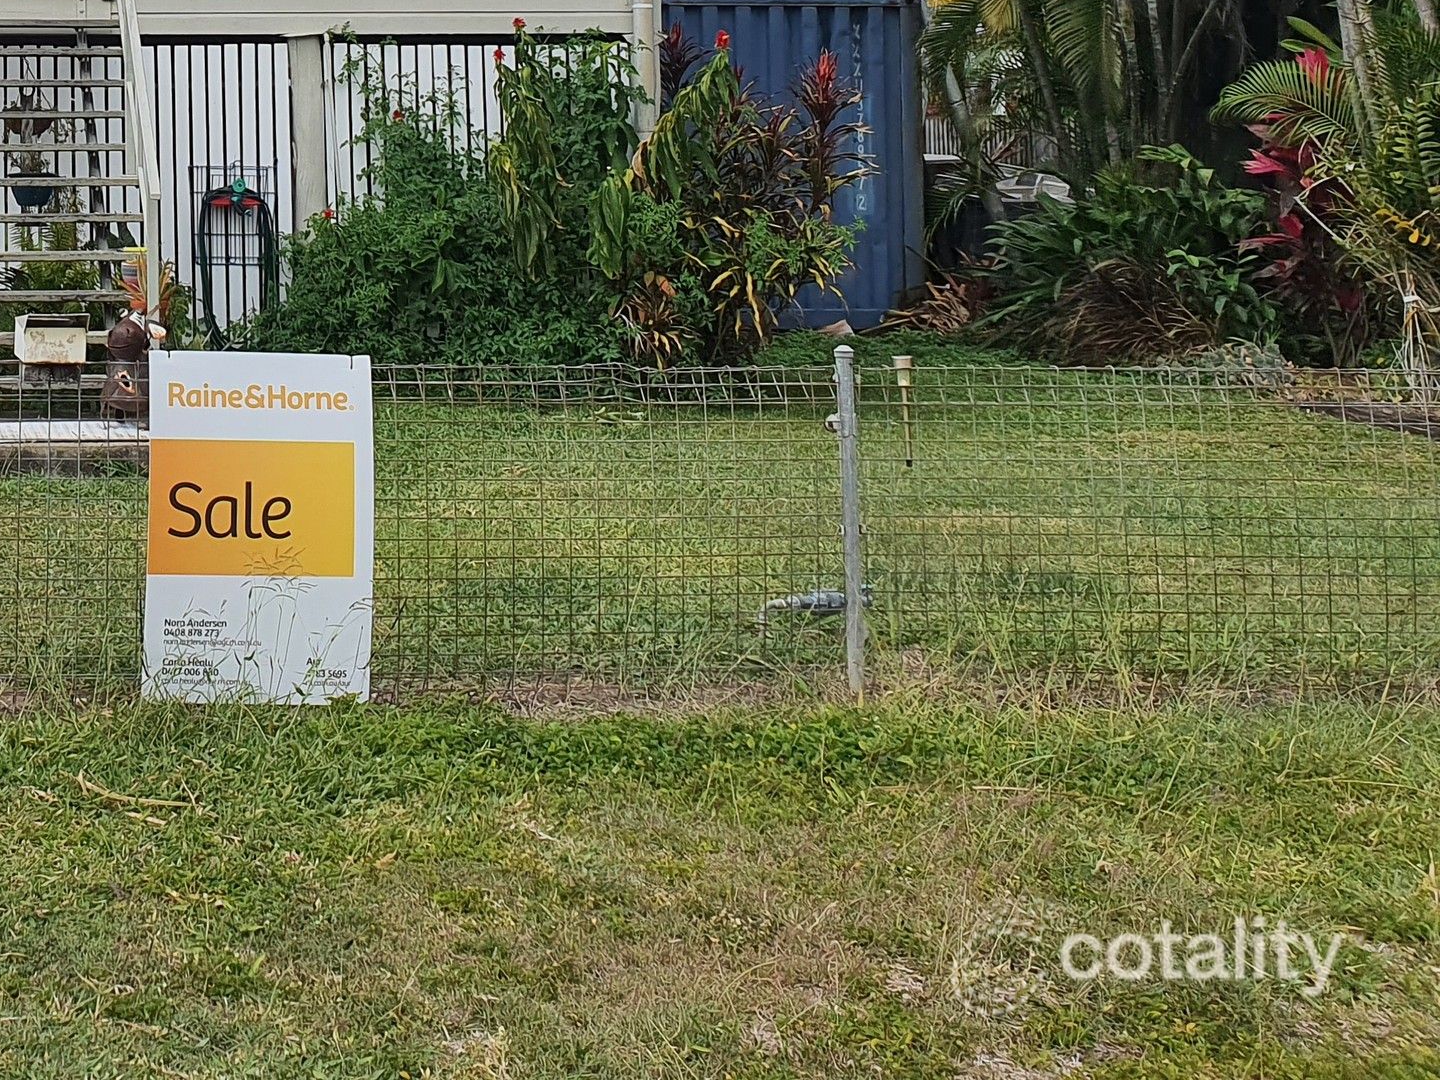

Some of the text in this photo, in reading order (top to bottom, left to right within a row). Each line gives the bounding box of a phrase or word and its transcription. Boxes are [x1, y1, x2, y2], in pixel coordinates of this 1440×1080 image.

[167, 480, 292, 539] Sale
[164, 619, 228, 628] Nora Andersen
[163, 628, 184, 636] 0408
[187, 629, 202, 637] 878
[184, 668, 200, 676] 006
[327, 669, 347, 678] 5695
